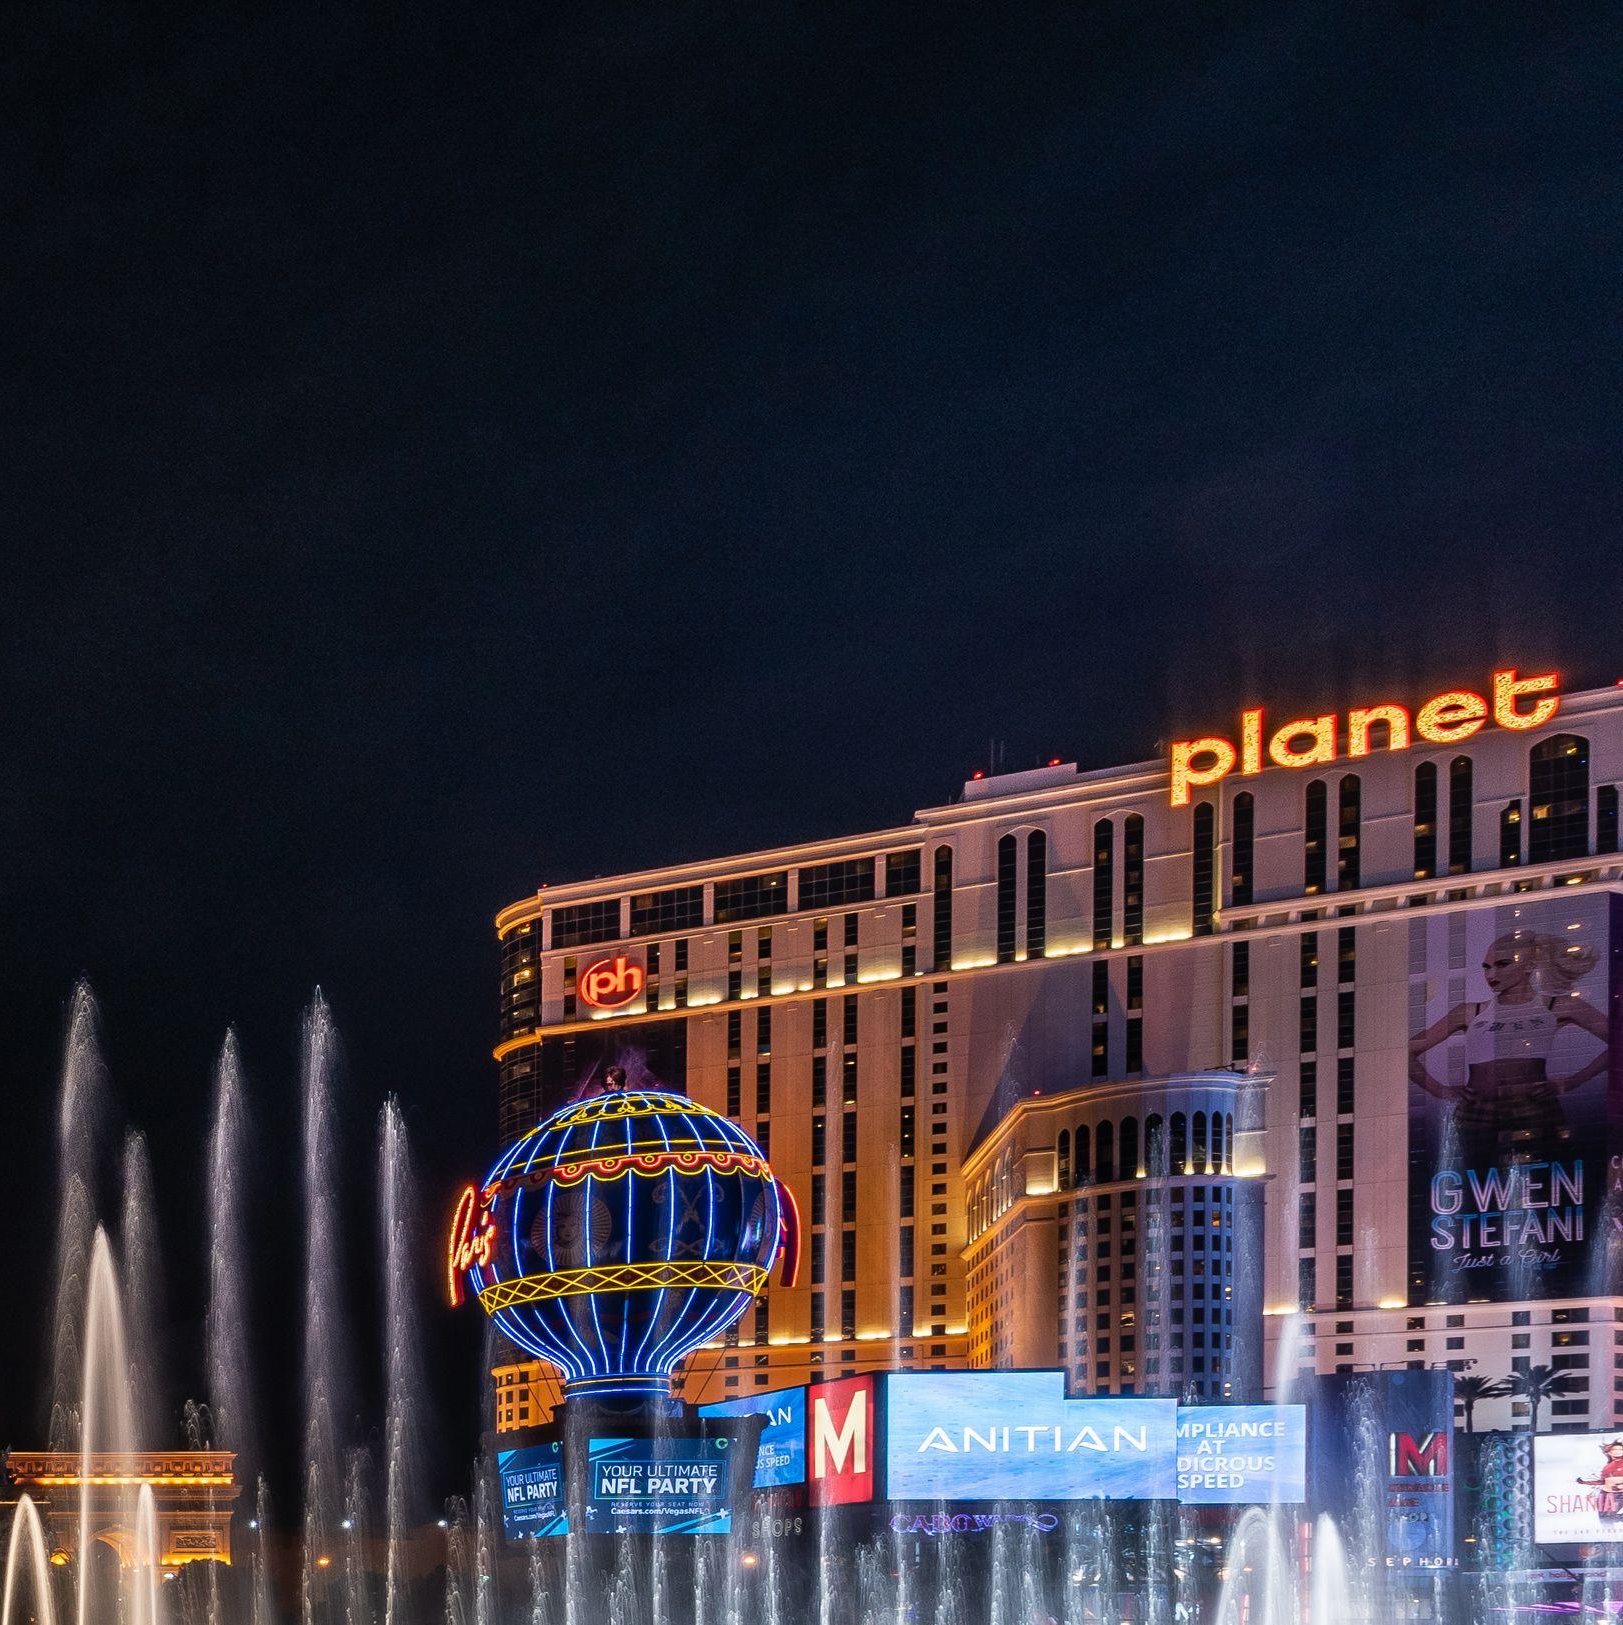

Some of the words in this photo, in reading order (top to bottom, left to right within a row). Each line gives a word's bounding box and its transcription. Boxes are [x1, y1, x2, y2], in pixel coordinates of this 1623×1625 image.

[1170, 669, 1560, 807] planet
[589, 957, 642, 1001] ph
[1431, 1160, 1583, 1215] GWEN
[1431, 1206, 1584, 1250] STEFANI
[449, 1186, 496, 1306] Paris
[1452, 1252, 1494, 1273] Just
[1500, 1254, 1512, 1265] a
[814, 1390, 867, 1479] M
[917, 1425, 1147, 1453] ANITIAN
[1197, 1439, 1225, 1455] AT
[603, 1465, 643, 1477] YOUR
[648, 1465, 718, 1477] ULTIMATE
[766, 1454, 791, 1468] SPEED
[1177, 1456, 1276, 1472] DICROUS
[506, 1473, 525, 1487] YOUR
[525, 1468, 557, 1485] ULTIMATE
[602, 1478, 642, 1494] NFL
[647, 1478, 717, 1494] PARTY
[1177, 1473, 1245, 1489] SPEED
[507, 1487, 526, 1503] NFL
[527, 1481, 557, 1500] PARTY
[611, 1507, 705, 1516] Caesars.com/VegasNFL
[889, 1514, 974, 1536] CABO
